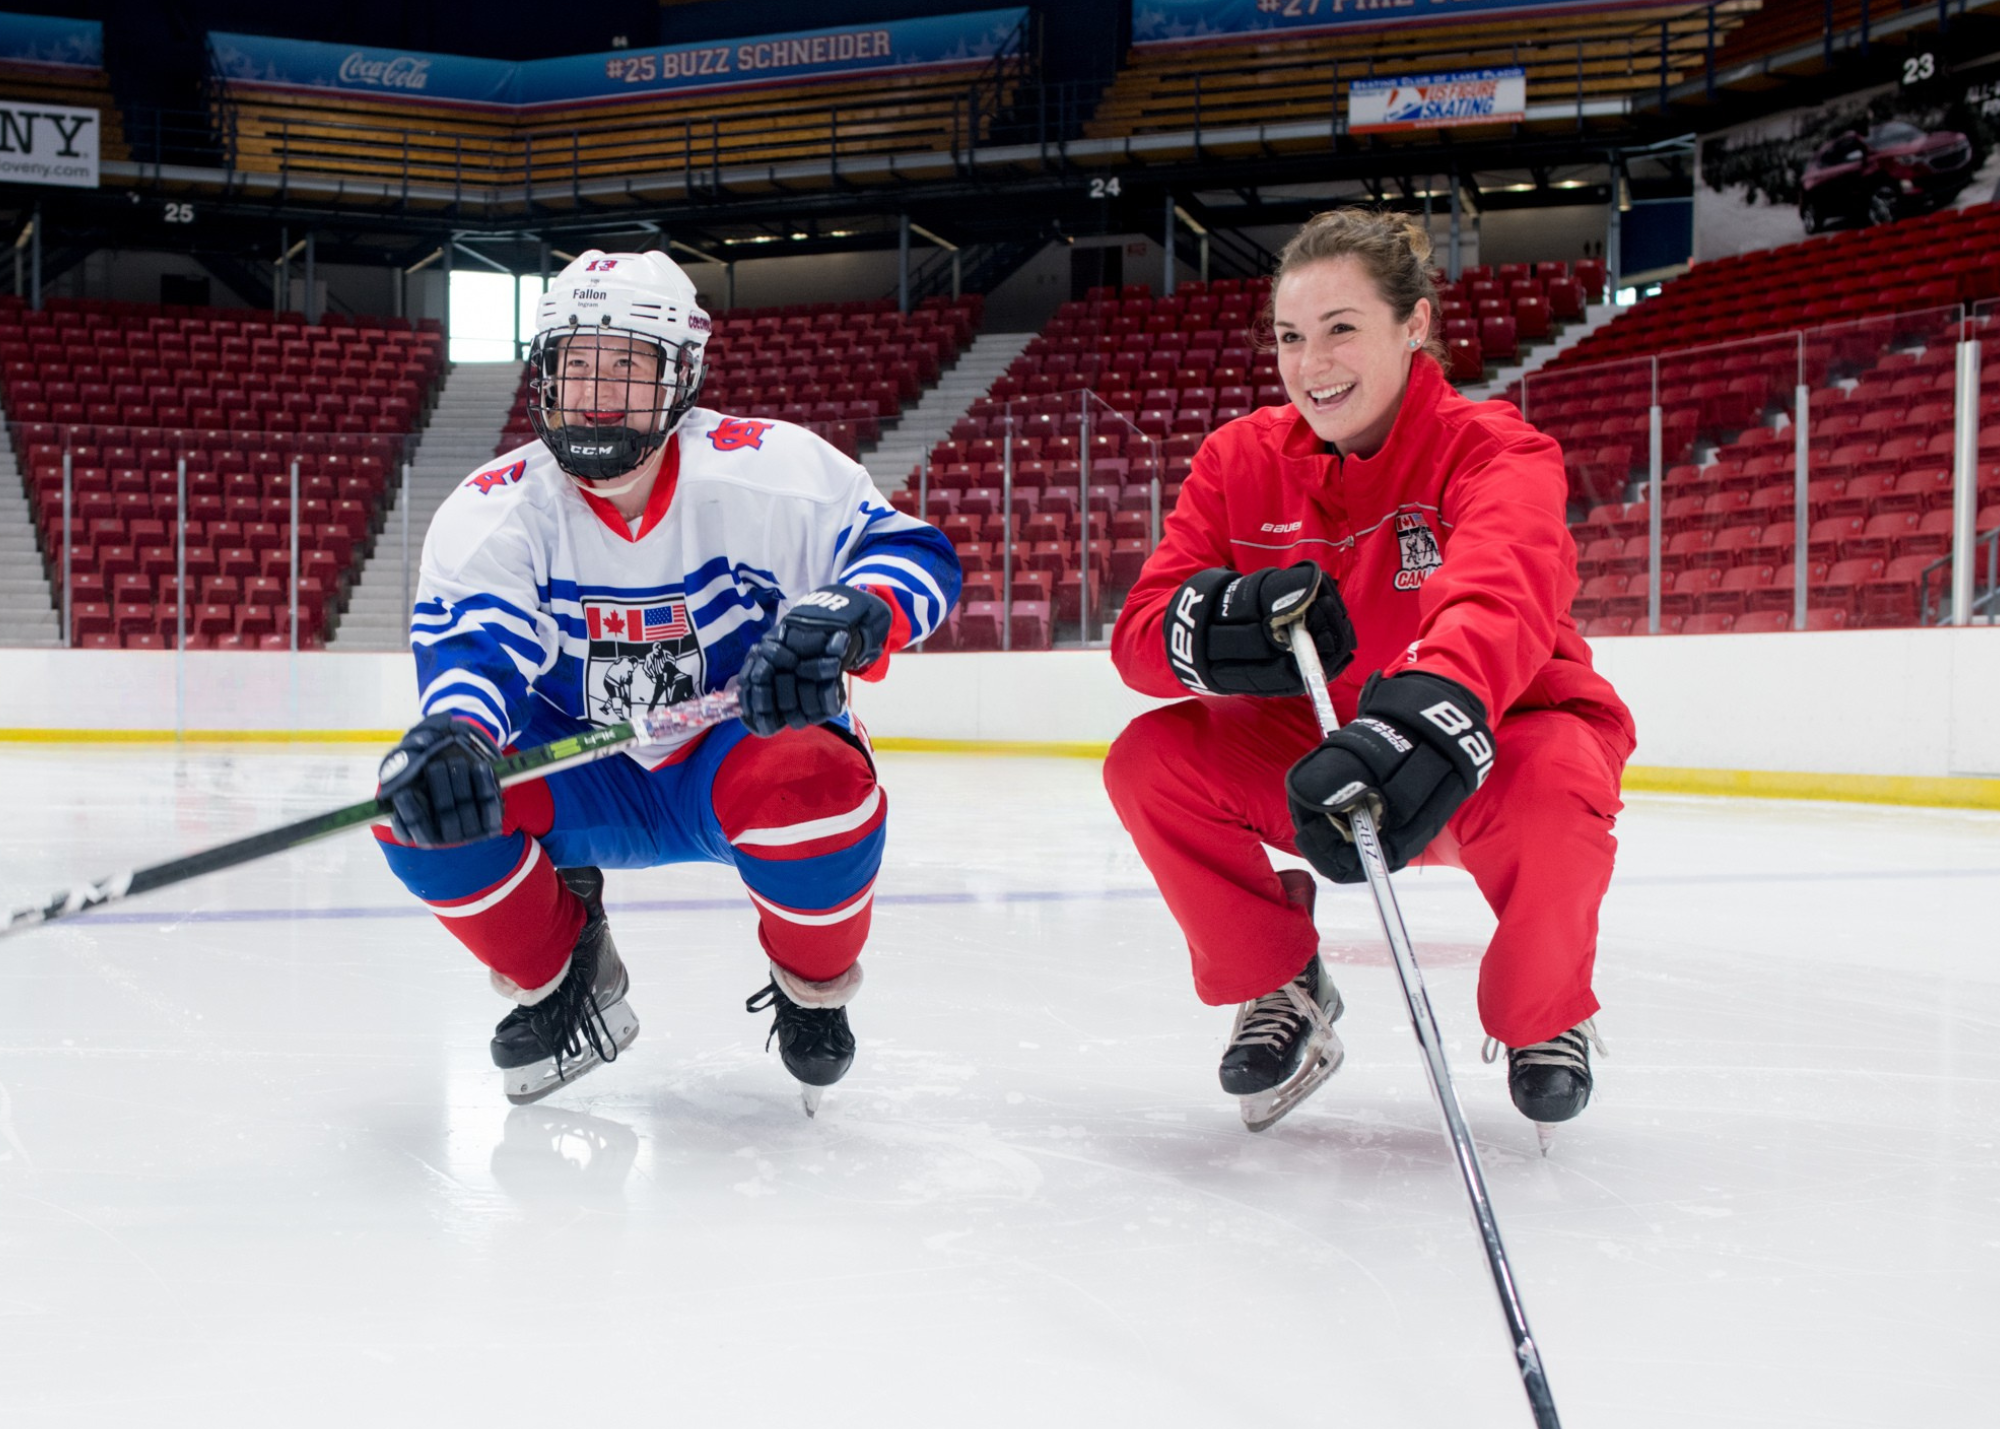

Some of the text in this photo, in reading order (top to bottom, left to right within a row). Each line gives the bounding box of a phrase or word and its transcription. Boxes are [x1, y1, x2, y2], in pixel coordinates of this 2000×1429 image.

[606, 30, 891, 82] #25 BUZZ SCHNEIDER
[1903, 52, 1935, 85] 23
[1423, 97, 1495, 119] SKATING
[0, 109, 94, 158] NY
[1089, 177, 1121, 198] 24
[164, 203, 193, 223] 25
[585, 259, 618, 272] 13
[572, 288, 607, 301] Fallon
[570, 445, 613, 455] CCM
